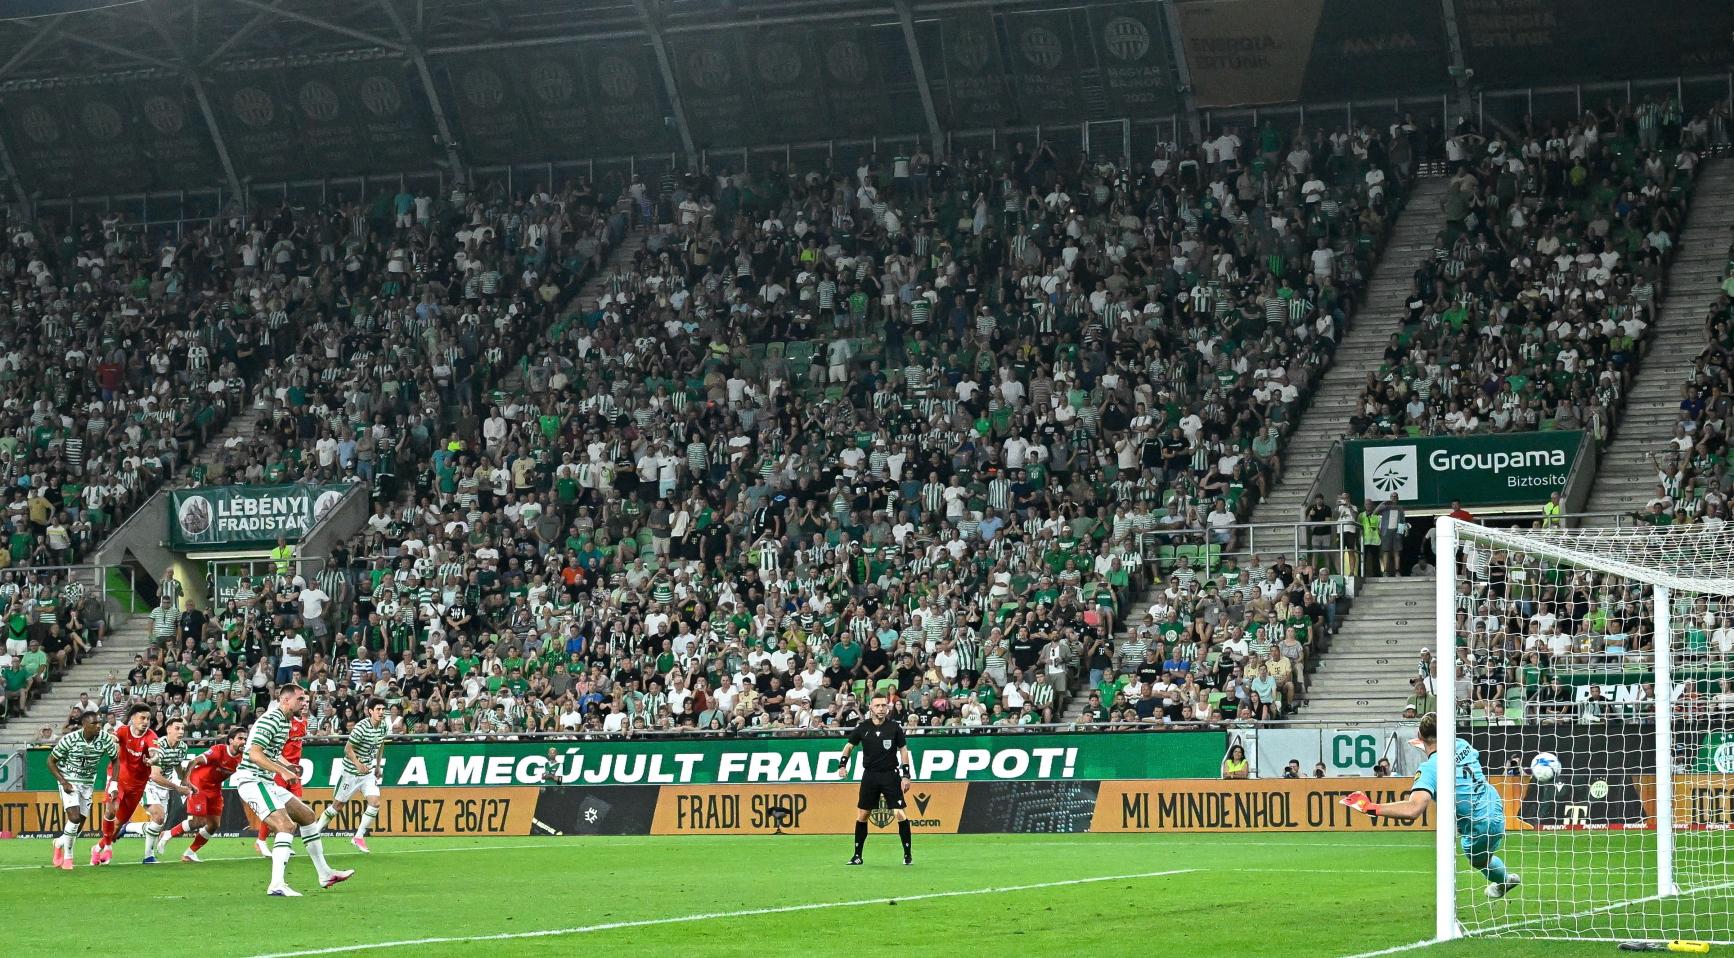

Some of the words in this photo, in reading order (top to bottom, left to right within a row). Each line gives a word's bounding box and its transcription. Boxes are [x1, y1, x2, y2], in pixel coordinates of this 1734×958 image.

[1429, 449, 1565, 473] Groupama
[1508, 474, 1566, 487] Biztosító
[219, 494, 308, 516] LÉBÉNYI
[219, 513, 307, 531] FRADISTÁK
[396, 757, 429, 785] A
[445, 748, 704, 785] MEGÚJULT
[1332, 734, 1377, 768] C6
[402, 799, 444, 832] MEZ
[455, 799, 510, 832] 26/27
[677, 794, 740, 829] FRADI
[752, 793, 808, 828] SHOP
[1122, 792, 1148, 828] MI
[1158, 791, 1299, 829] MINDENHOL
[1307, 791, 1352, 827] OTT
